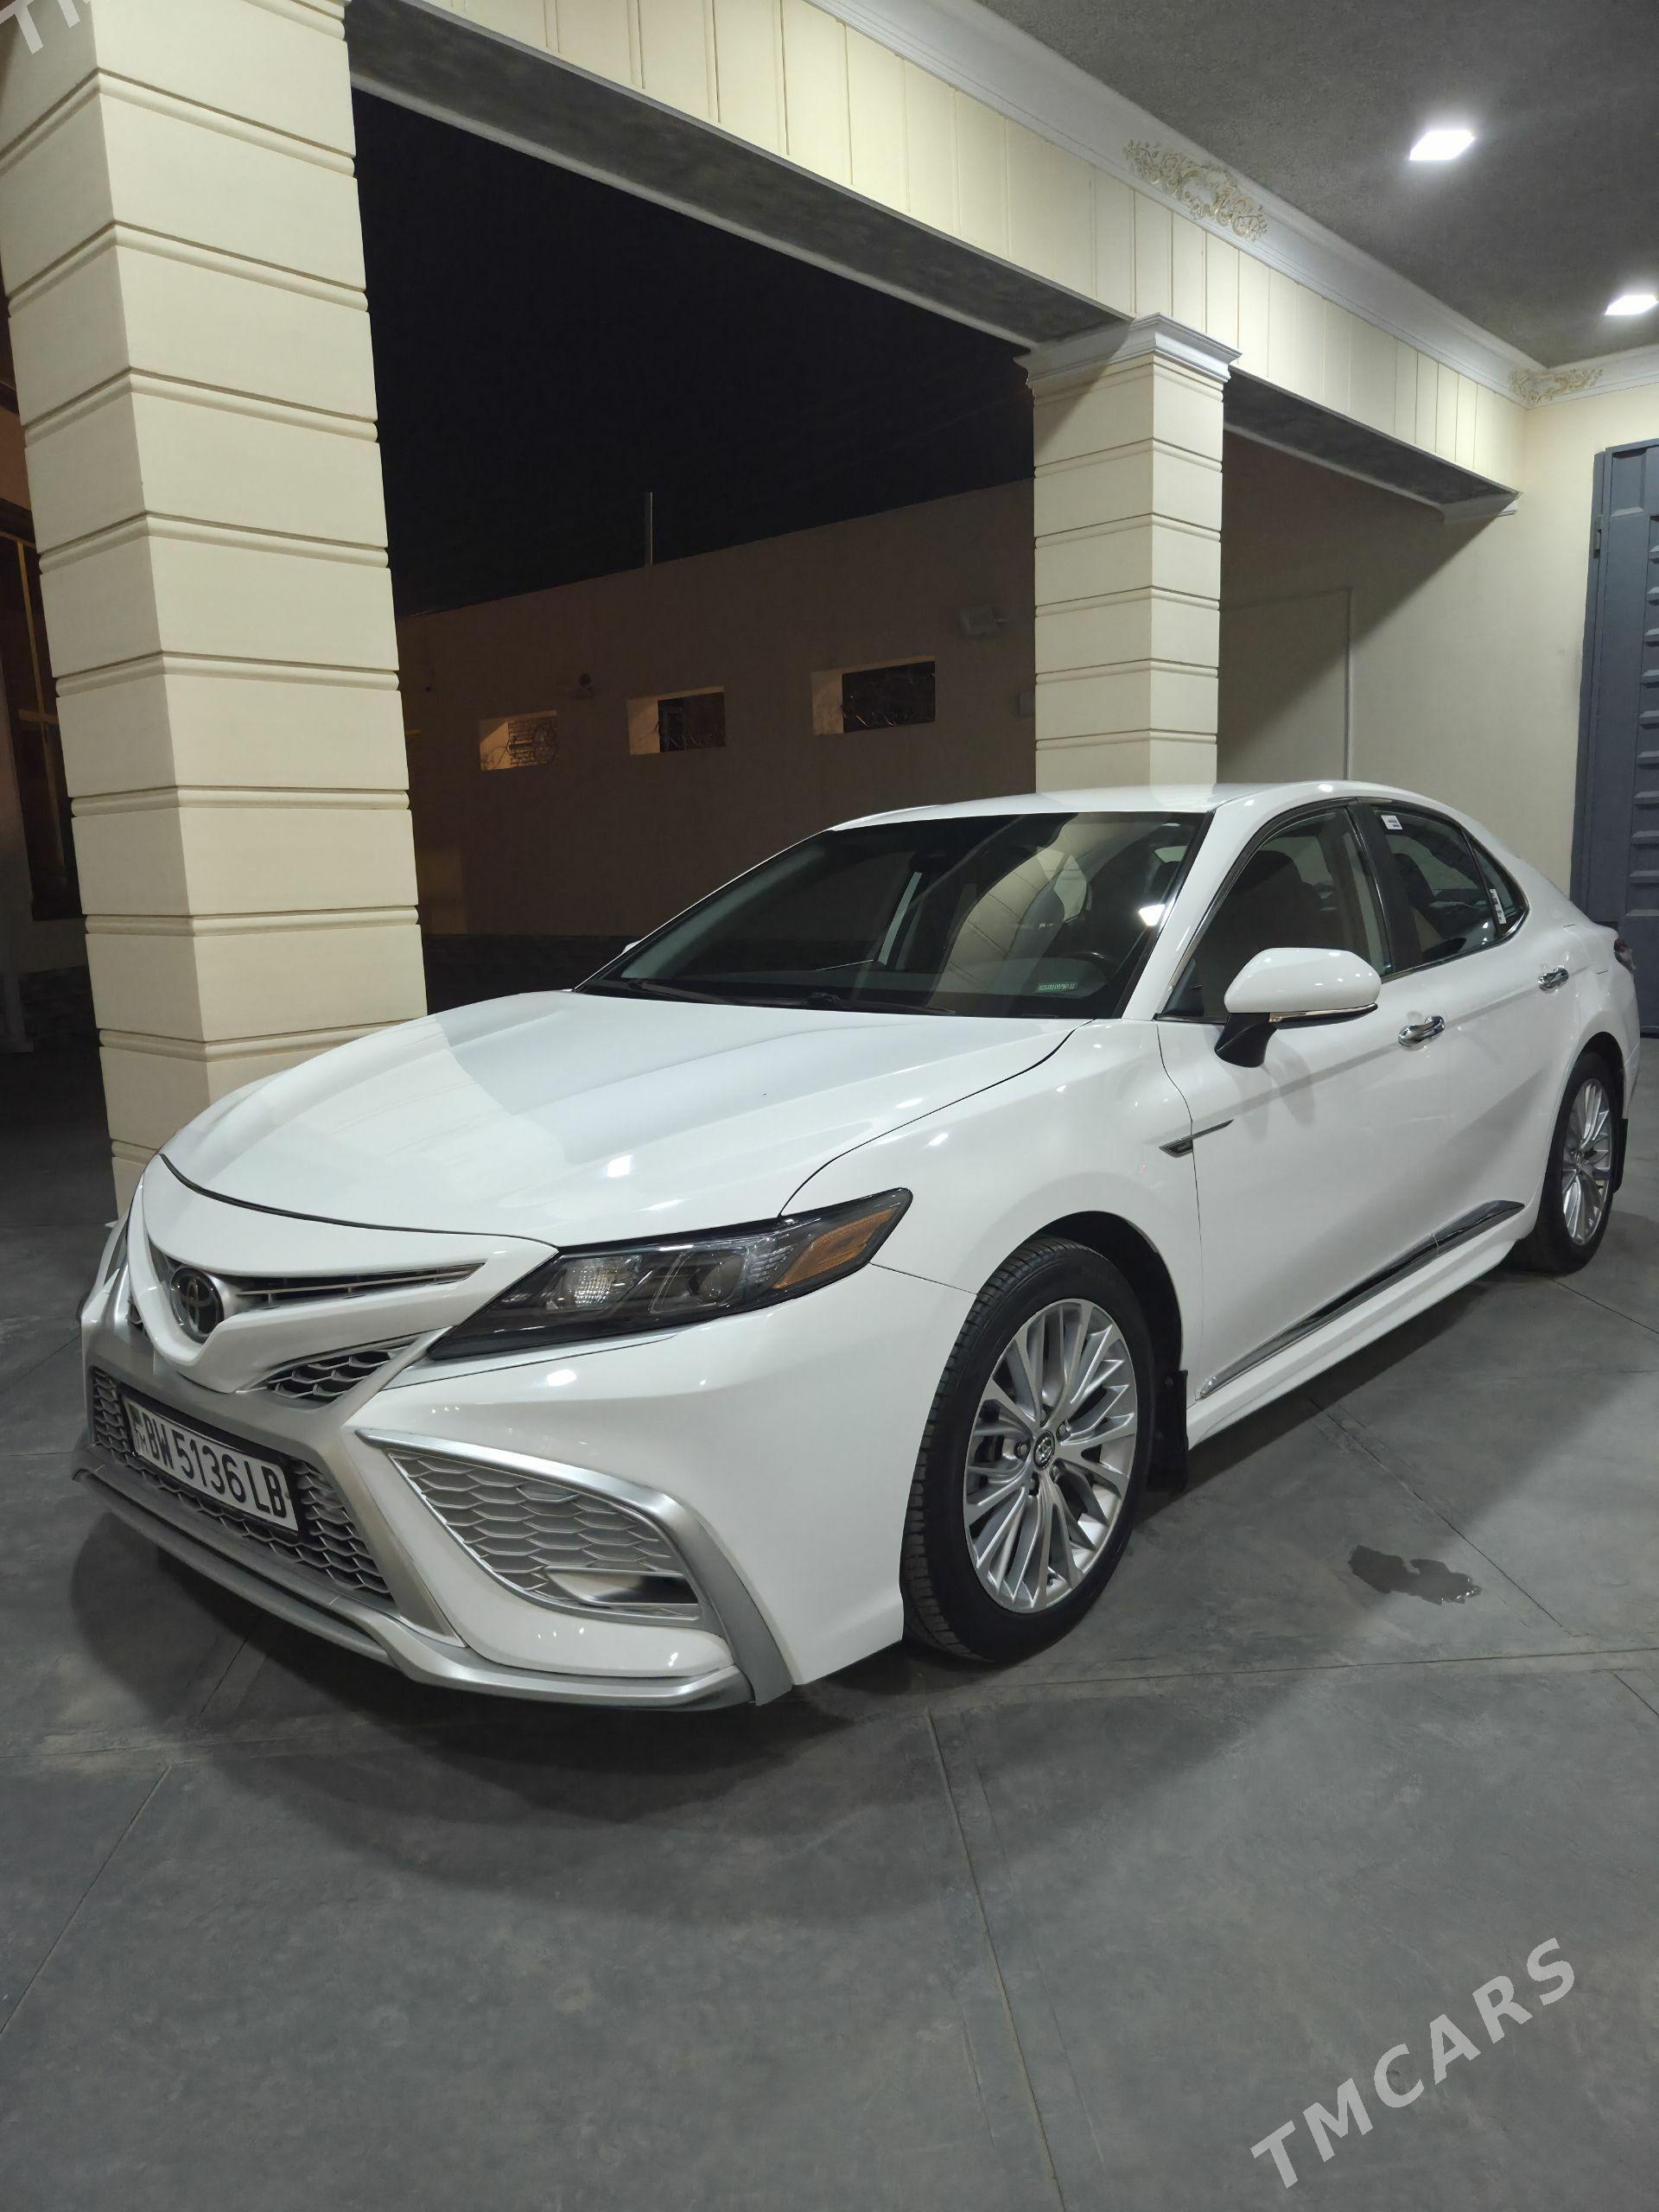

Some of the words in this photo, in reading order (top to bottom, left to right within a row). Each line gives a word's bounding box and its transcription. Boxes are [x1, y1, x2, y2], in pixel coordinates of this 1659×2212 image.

[143, 1412, 174, 1470] BW
[173, 1430, 247, 1503] 5136
[244, 1460, 287, 1519] LB
